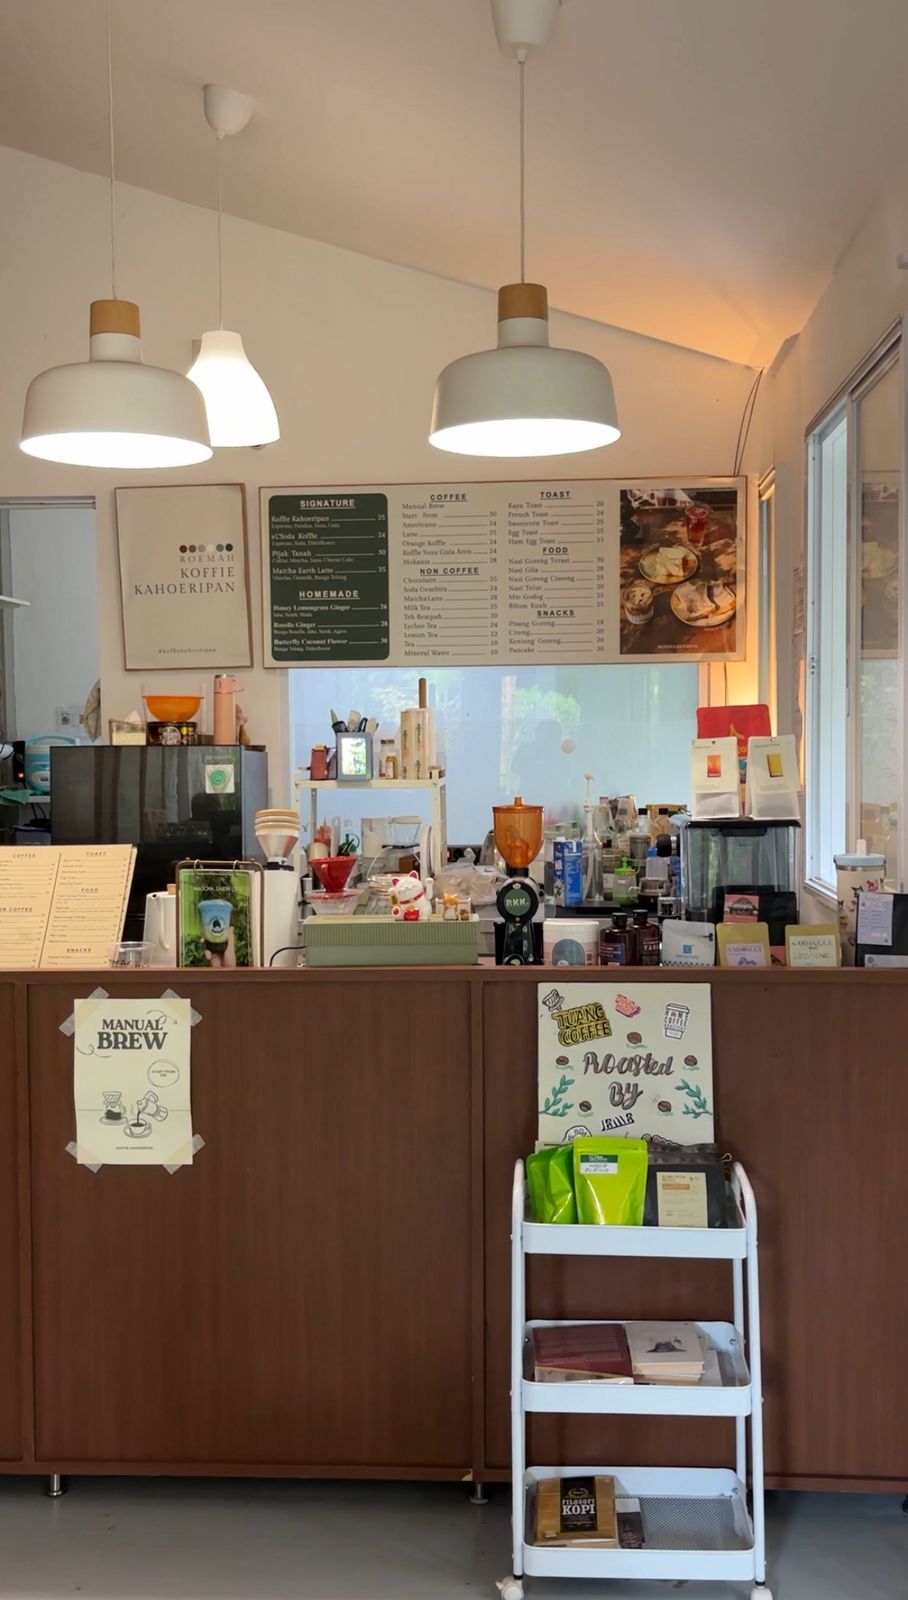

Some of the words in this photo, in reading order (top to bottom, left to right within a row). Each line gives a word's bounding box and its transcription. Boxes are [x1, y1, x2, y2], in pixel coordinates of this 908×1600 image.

[300, 499, 355, 507] SIGNATURE
[508, 529, 519, 537] Egg
[180, 554, 234, 563] ROEMAH
[181, 566, 236, 579] KOFFIE
[134, 582, 235, 595] KAHOERIPAN
[299, 590, 359, 598] HOMEMADE
[555, 1004, 605, 1029] TUANG
[102, 1019, 164, 1031] MANUAL
[562, 1020, 610, 1045] COFFEE
[97, 1032, 168, 1050] BREW
[562, 1504, 596, 1515] KOPI
